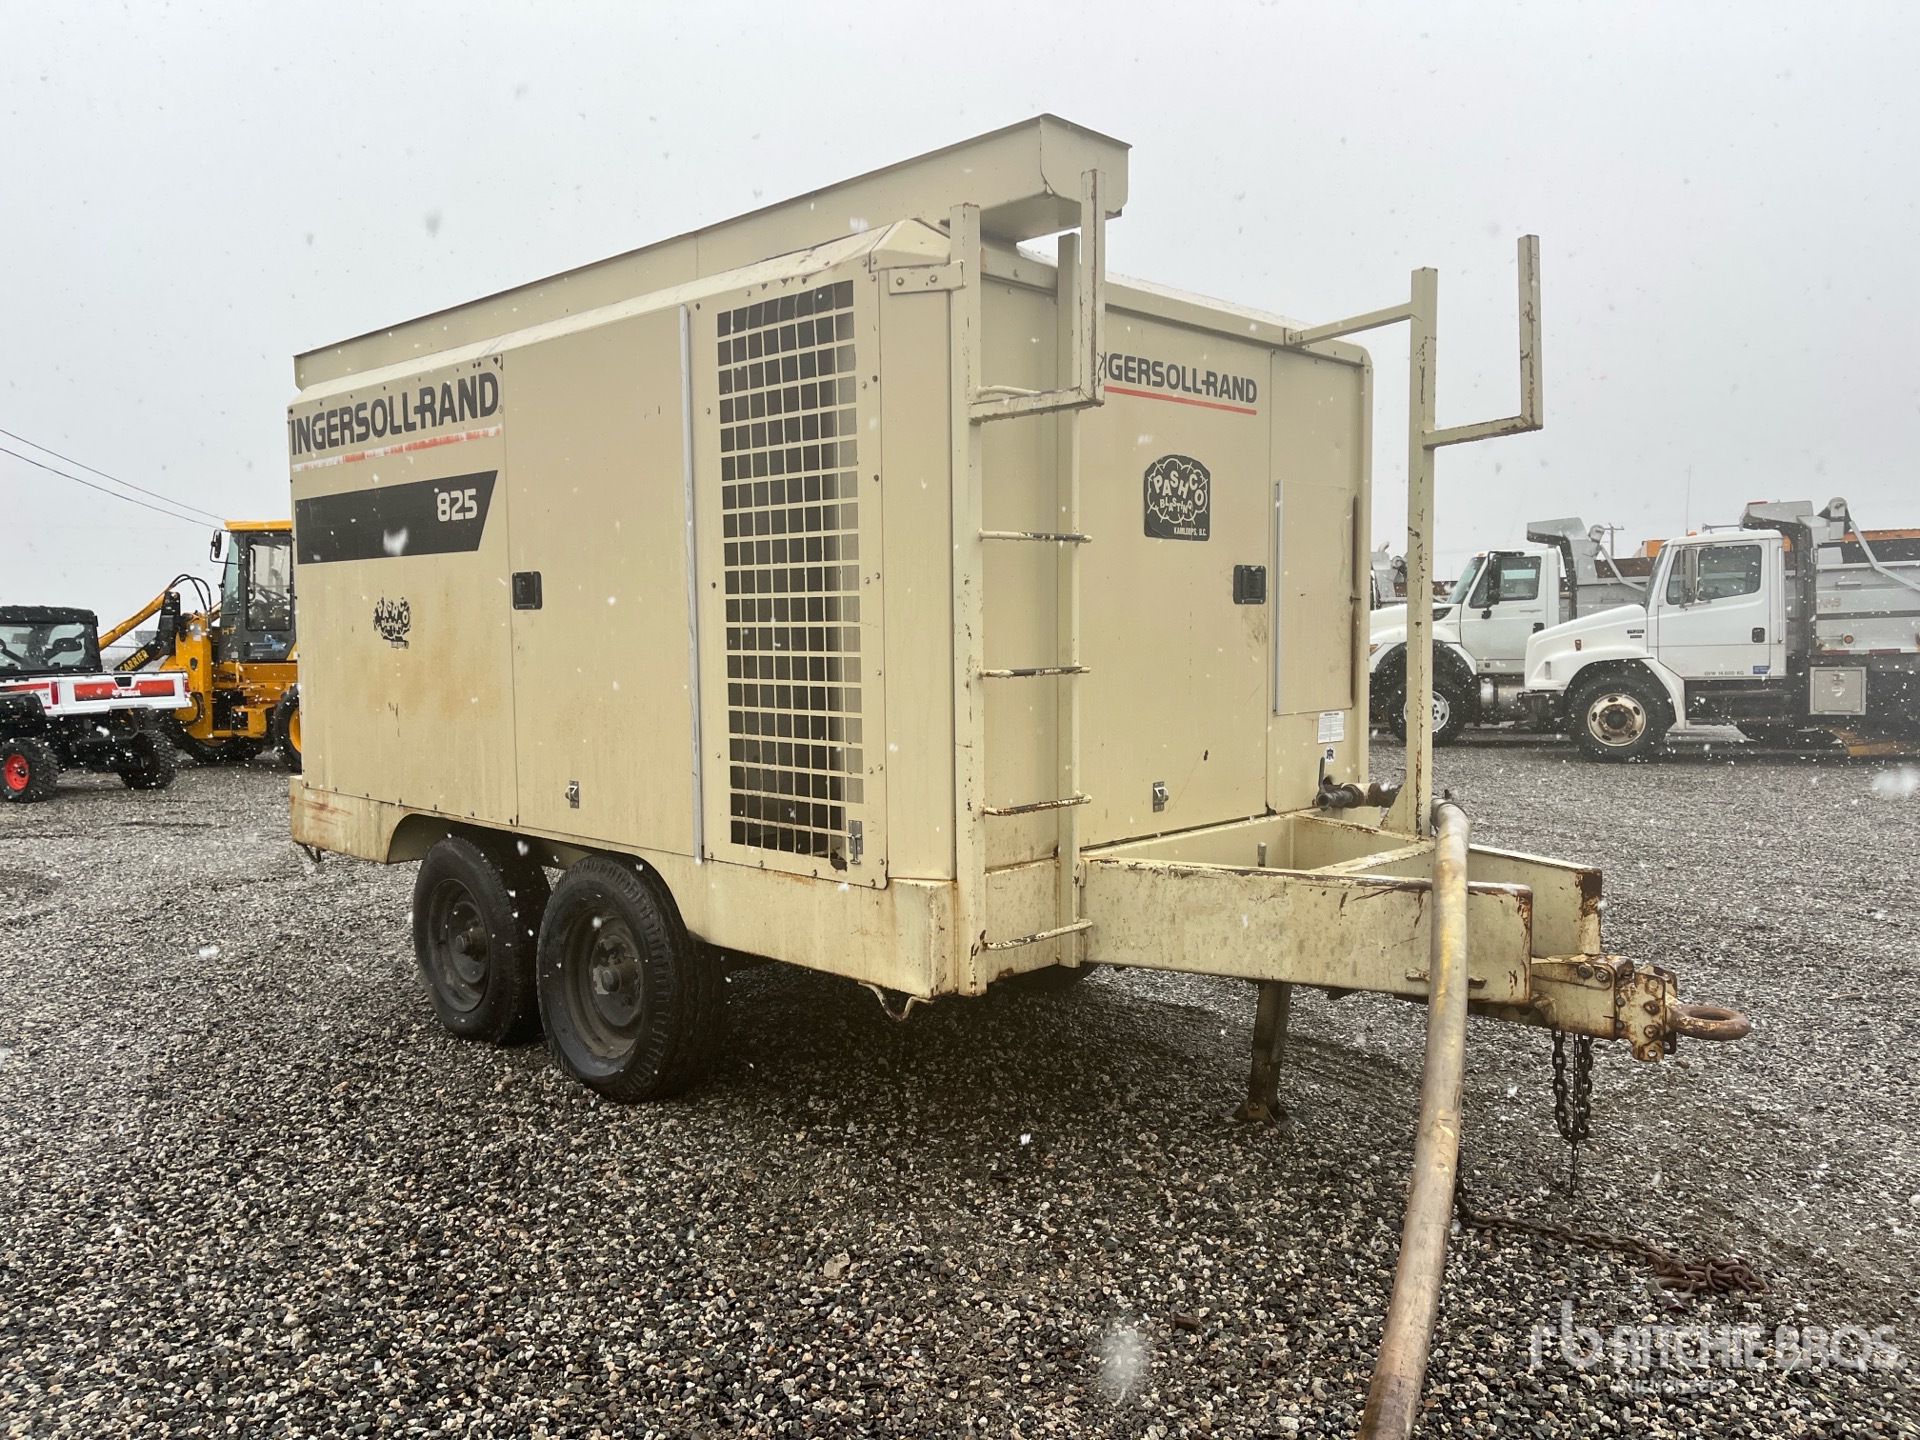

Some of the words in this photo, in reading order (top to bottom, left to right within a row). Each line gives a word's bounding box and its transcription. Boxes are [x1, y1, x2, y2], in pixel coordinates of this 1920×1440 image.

[1104, 352, 1257, 403] GERSOLL-RAND
[291, 371, 499, 456] INGERSOLL-RAND
[436, 488, 478, 522] 825
[1153, 470, 1204, 506] PASHCO
[1160, 496, 1193, 514] BLASTING
[119, 649, 149, 671] CARRIER
